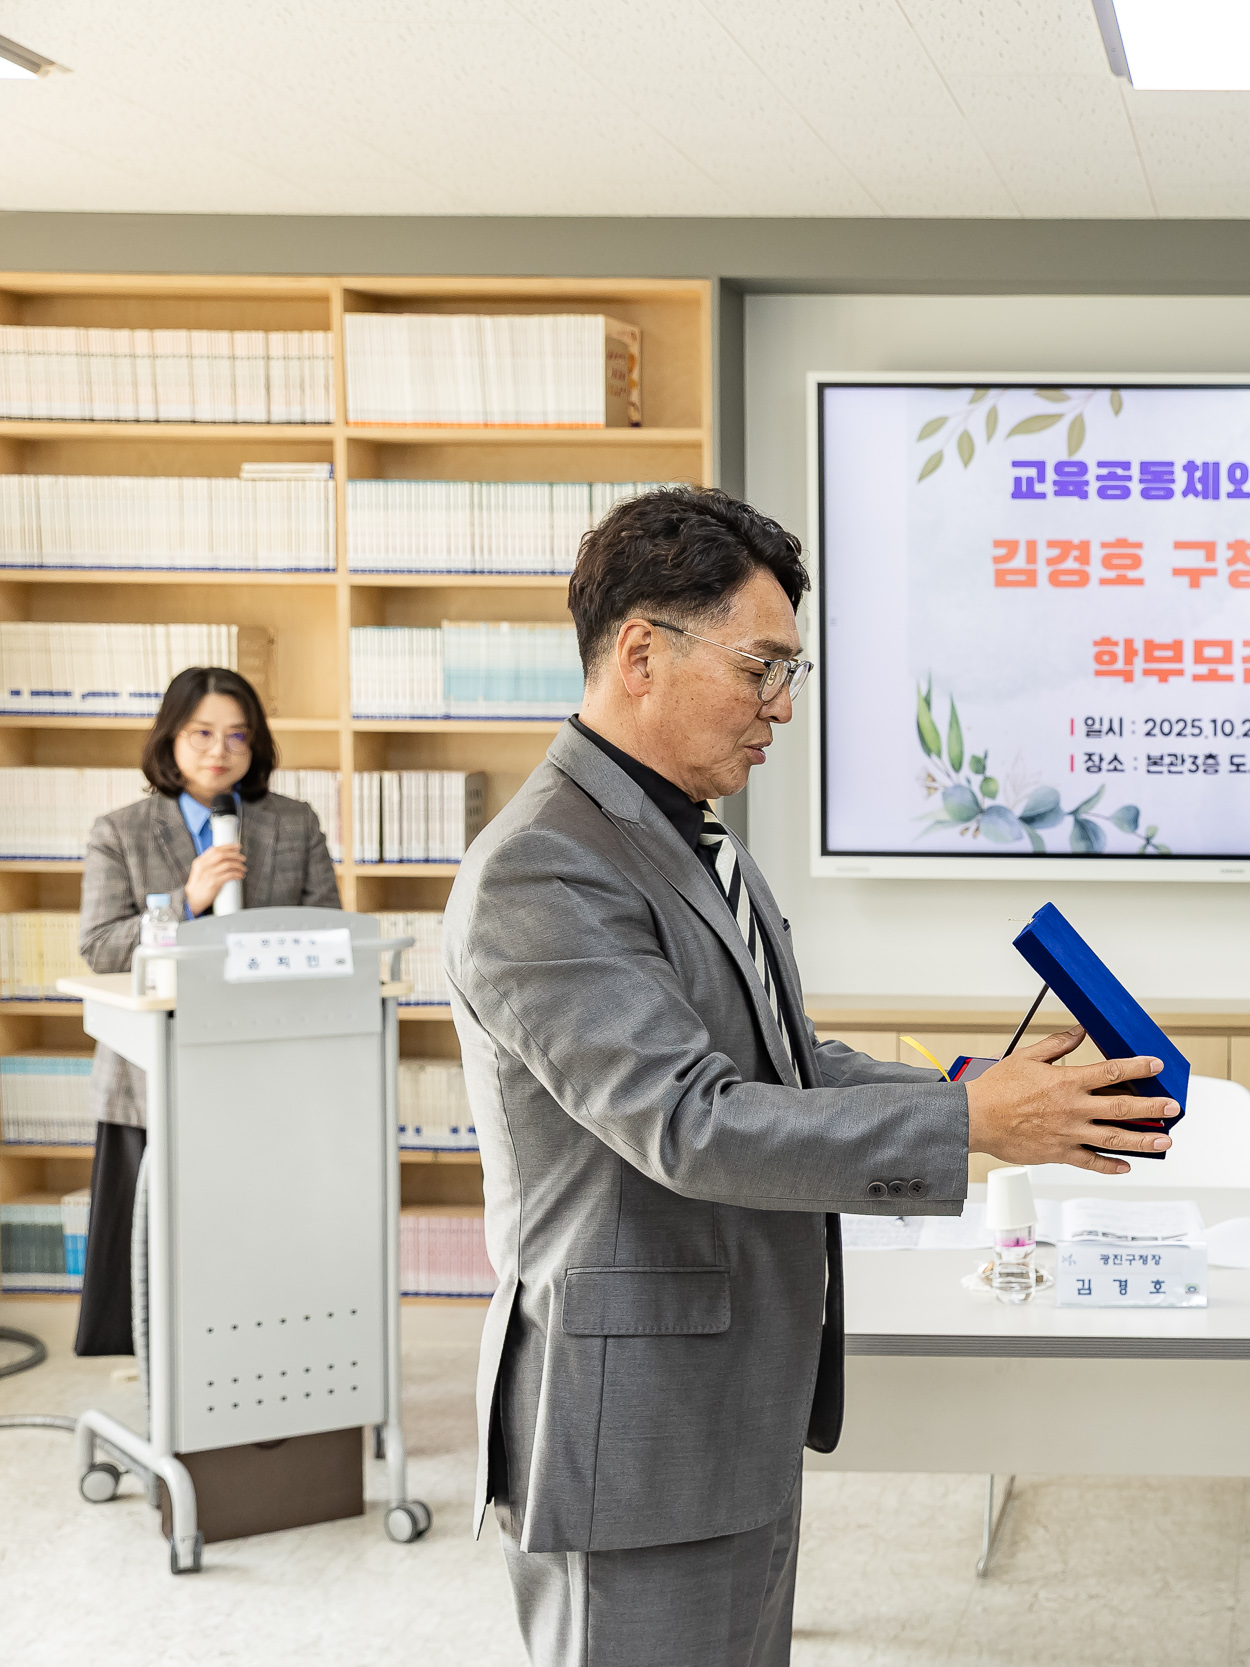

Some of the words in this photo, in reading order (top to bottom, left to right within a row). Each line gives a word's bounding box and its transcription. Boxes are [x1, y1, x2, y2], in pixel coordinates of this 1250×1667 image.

[991, 538, 1146, 590] 김경호
[1083, 715, 1124, 739] 일시
[1084, 752, 1126, 774] 장소
[1146, 752, 1221, 776] 본관3층
